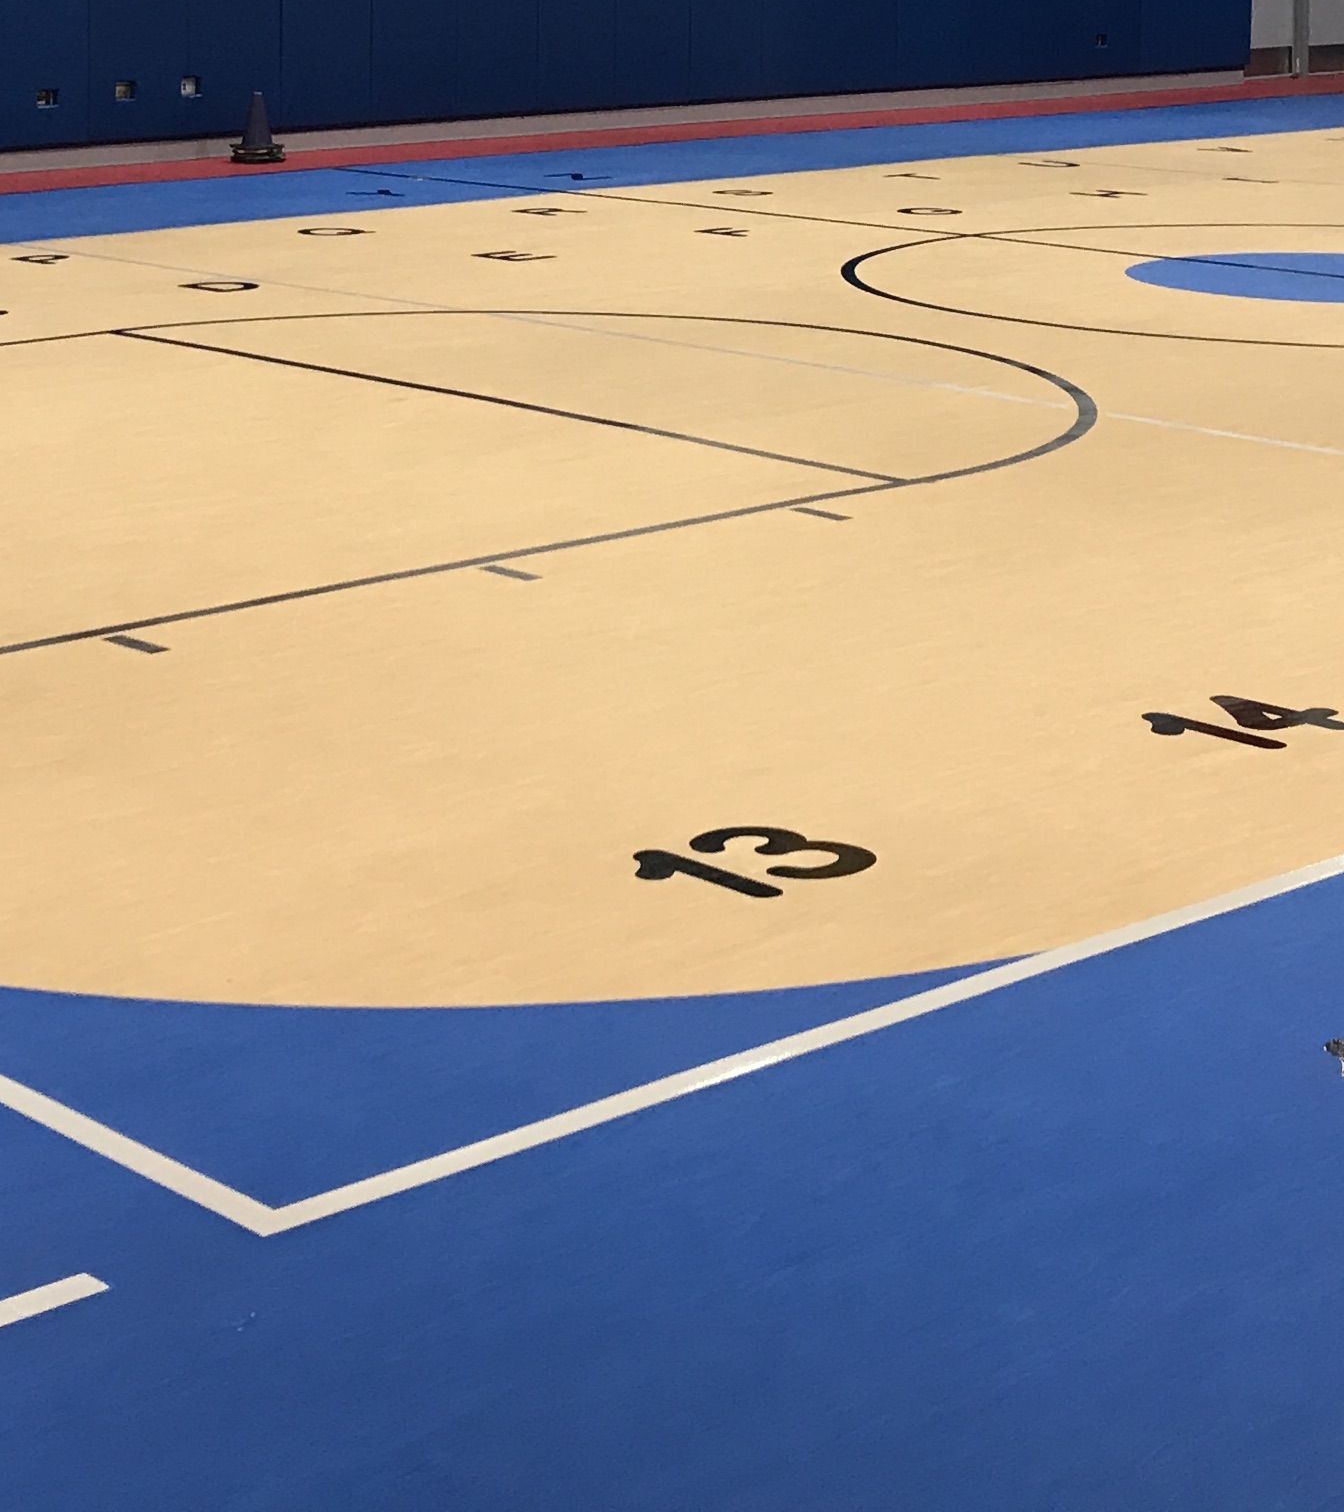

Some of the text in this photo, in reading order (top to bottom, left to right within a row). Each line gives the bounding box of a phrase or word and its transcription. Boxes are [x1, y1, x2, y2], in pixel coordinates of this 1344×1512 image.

[470, 250, 557, 262] E
[177, 281, 260, 293] D
[633, 827, 877, 898] 13
